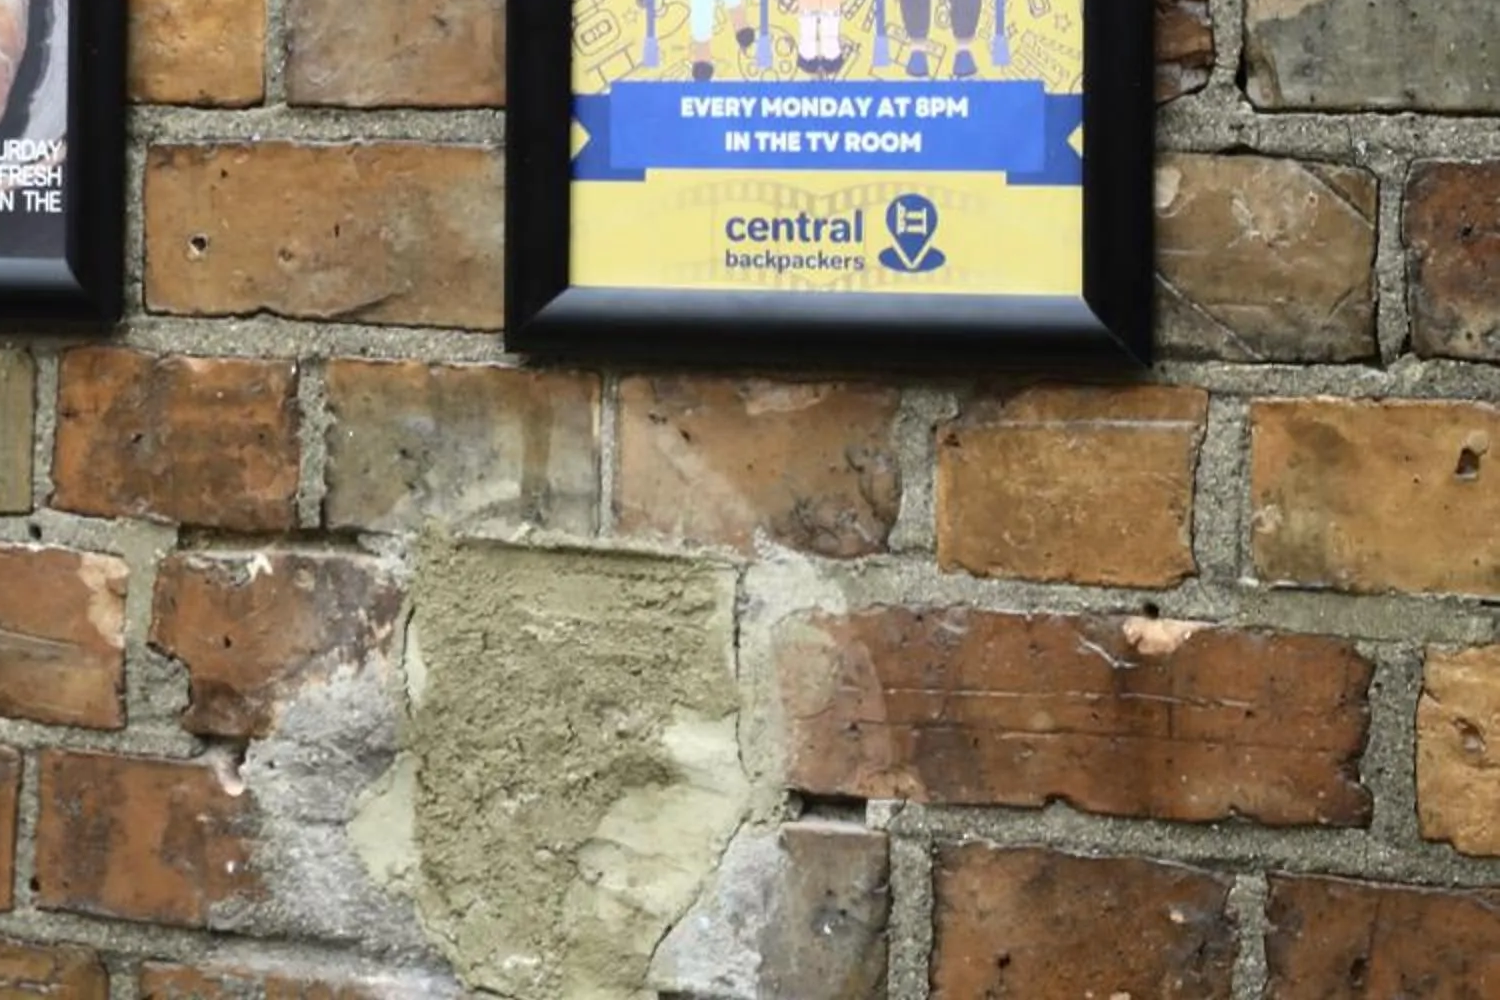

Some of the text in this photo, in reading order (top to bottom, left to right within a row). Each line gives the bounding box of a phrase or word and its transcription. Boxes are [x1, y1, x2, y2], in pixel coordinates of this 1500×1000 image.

[680, 96, 970, 119] EVERY MONDAY AT 8PM
[725, 131, 923, 154] IN THE TV ROOM
[22, 191, 63, 213] THE
[725, 209, 864, 244] central
[725, 248, 866, 274] backpackers
